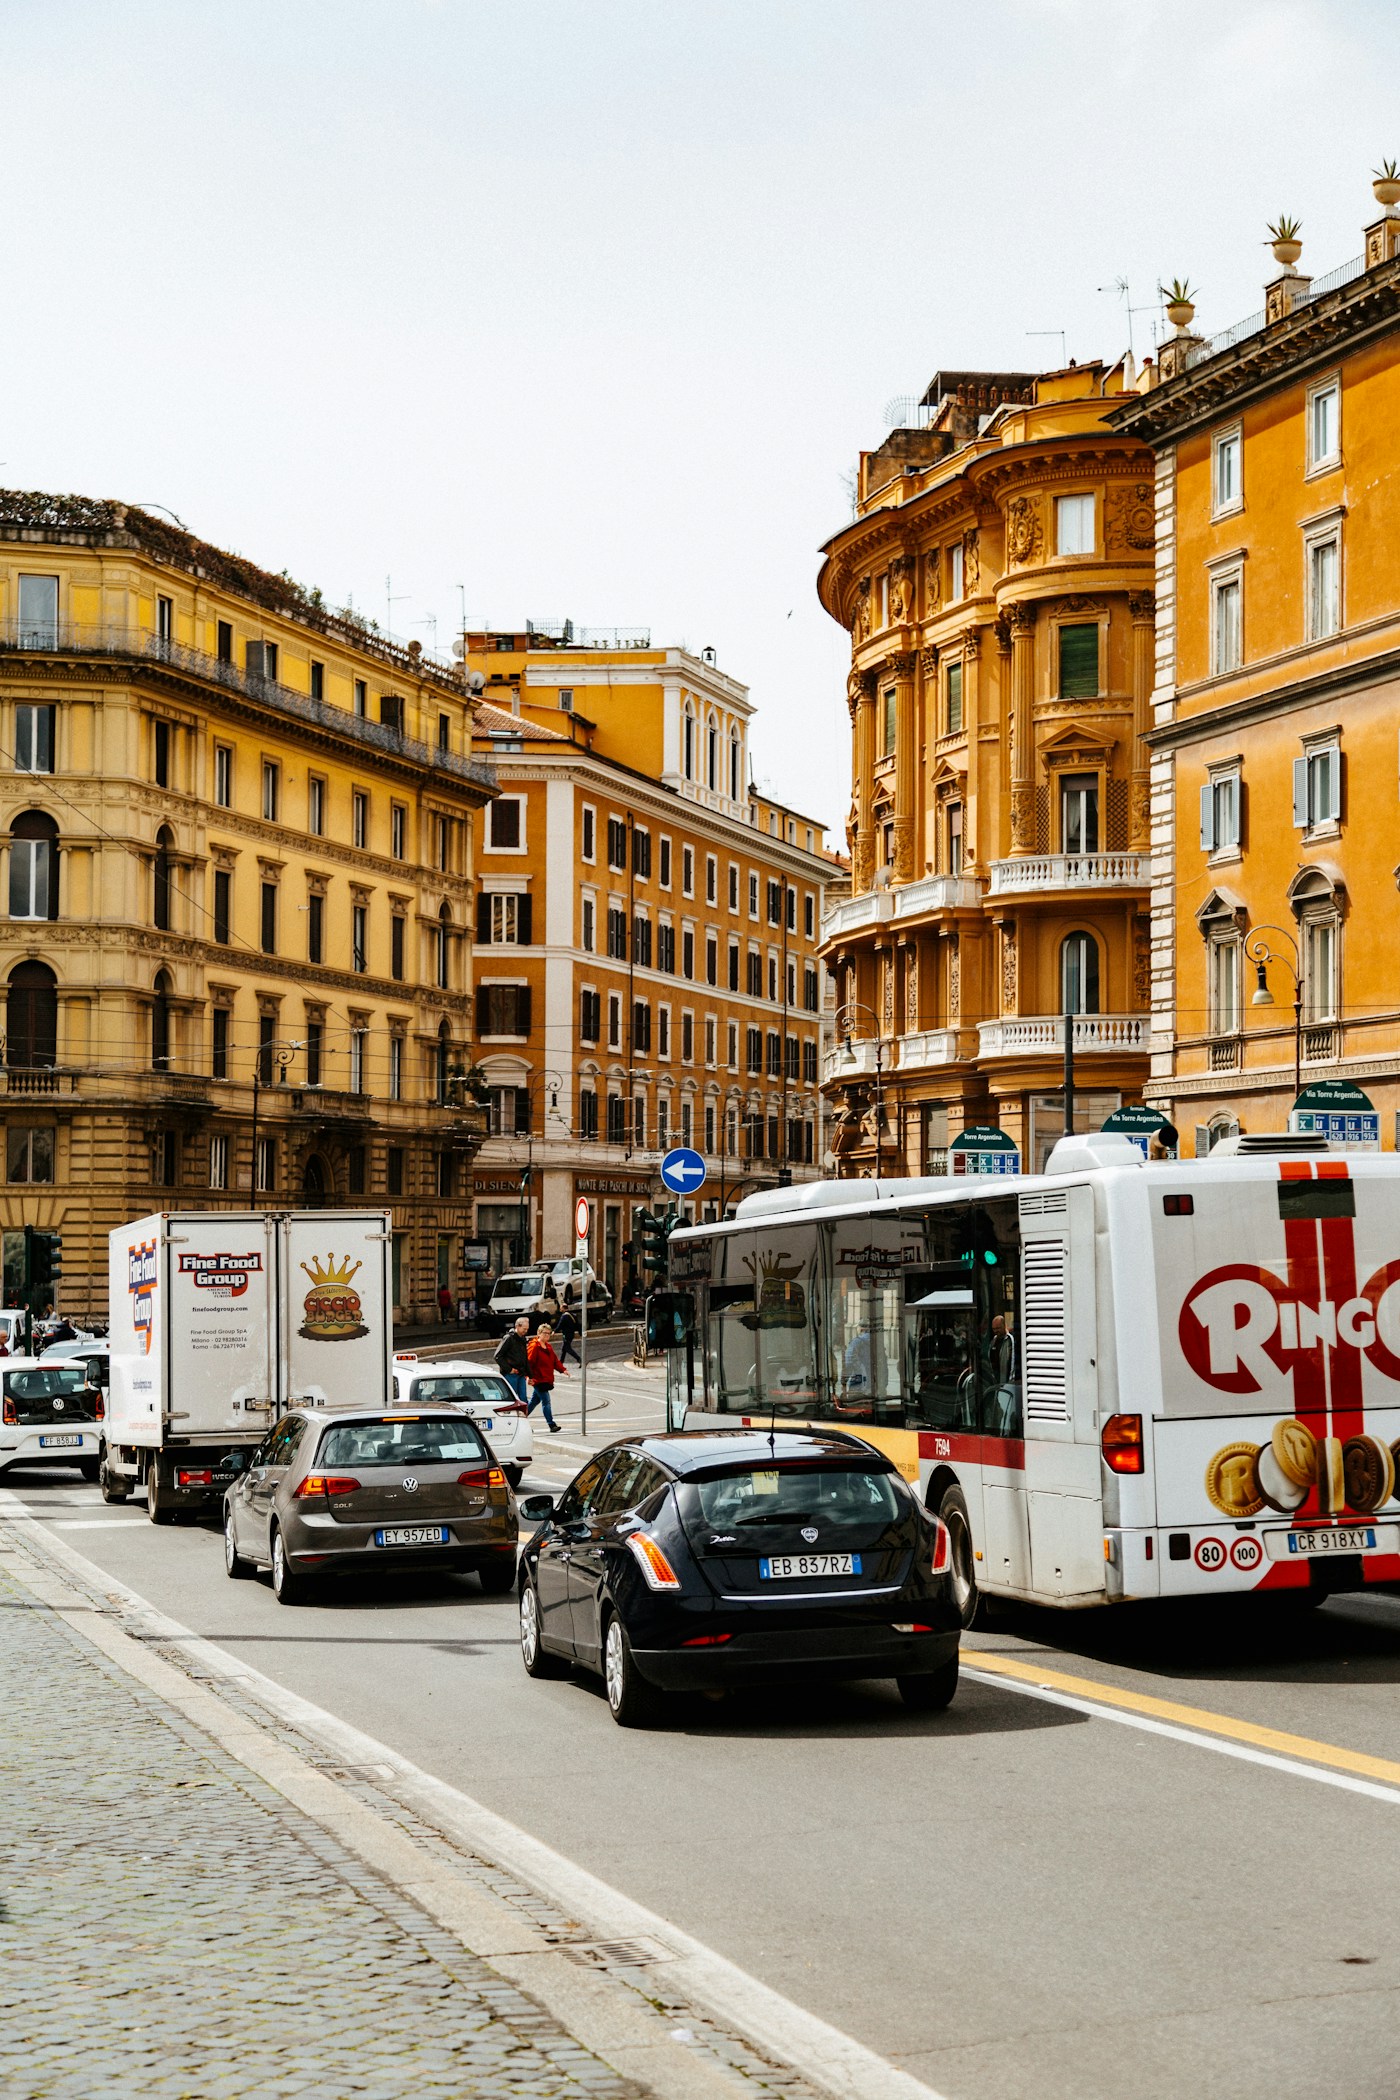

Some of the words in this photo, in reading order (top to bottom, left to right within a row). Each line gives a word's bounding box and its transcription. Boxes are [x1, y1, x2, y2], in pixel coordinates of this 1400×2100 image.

[1306, 1090, 1316, 1098] Via
[1317, 1090, 1333, 1098] Torre
[1334, 1091, 1364, 1100] Argentina
[1112, 1114, 1121, 1122] Via
[1121, 1114, 1136, 1122] Torre
[1136, 1115, 1164, 1123] Argentina
[1363, 1132, 1376, 1140] 916
[475, 1181, 486, 1190] DI
[489, 1181, 523, 1190] SIENA
[578, 1179, 597, 1191] MONTE
[598, 1180, 608, 1191] DEI
[609, 1180, 628, 1192] PASCHI
[629, 1181, 635, 1193] DI
[636, 1182, 651, 1193] SIENA
[129, 1255, 142, 1284] Fine
[141, 1249, 156, 1282] Food
[182, 1256, 217, 1269] Fine
[219, 1256, 258, 1269] Food
[196, 1272, 246, 1287] Group
[304, 1296, 361, 1313] CICCIO
[305, 1310, 362, 1323] BURGER
[45, 1437, 54, 1446] FF
[934, 1438, 951, 1455] 7594
[384, 1530, 399, 1543] EY
[403, 1528, 441, 1541] 957ED
[1299, 1534, 1316, 1550] CR
[1320, 1531, 1365, 1548] 918XY
[1202, 1546, 1220, 1562] 80
[1236, 1548, 1256, 1561] 100
[771, 1558, 792, 1576] EB
[799, 1555, 851, 1574] 837RZ
